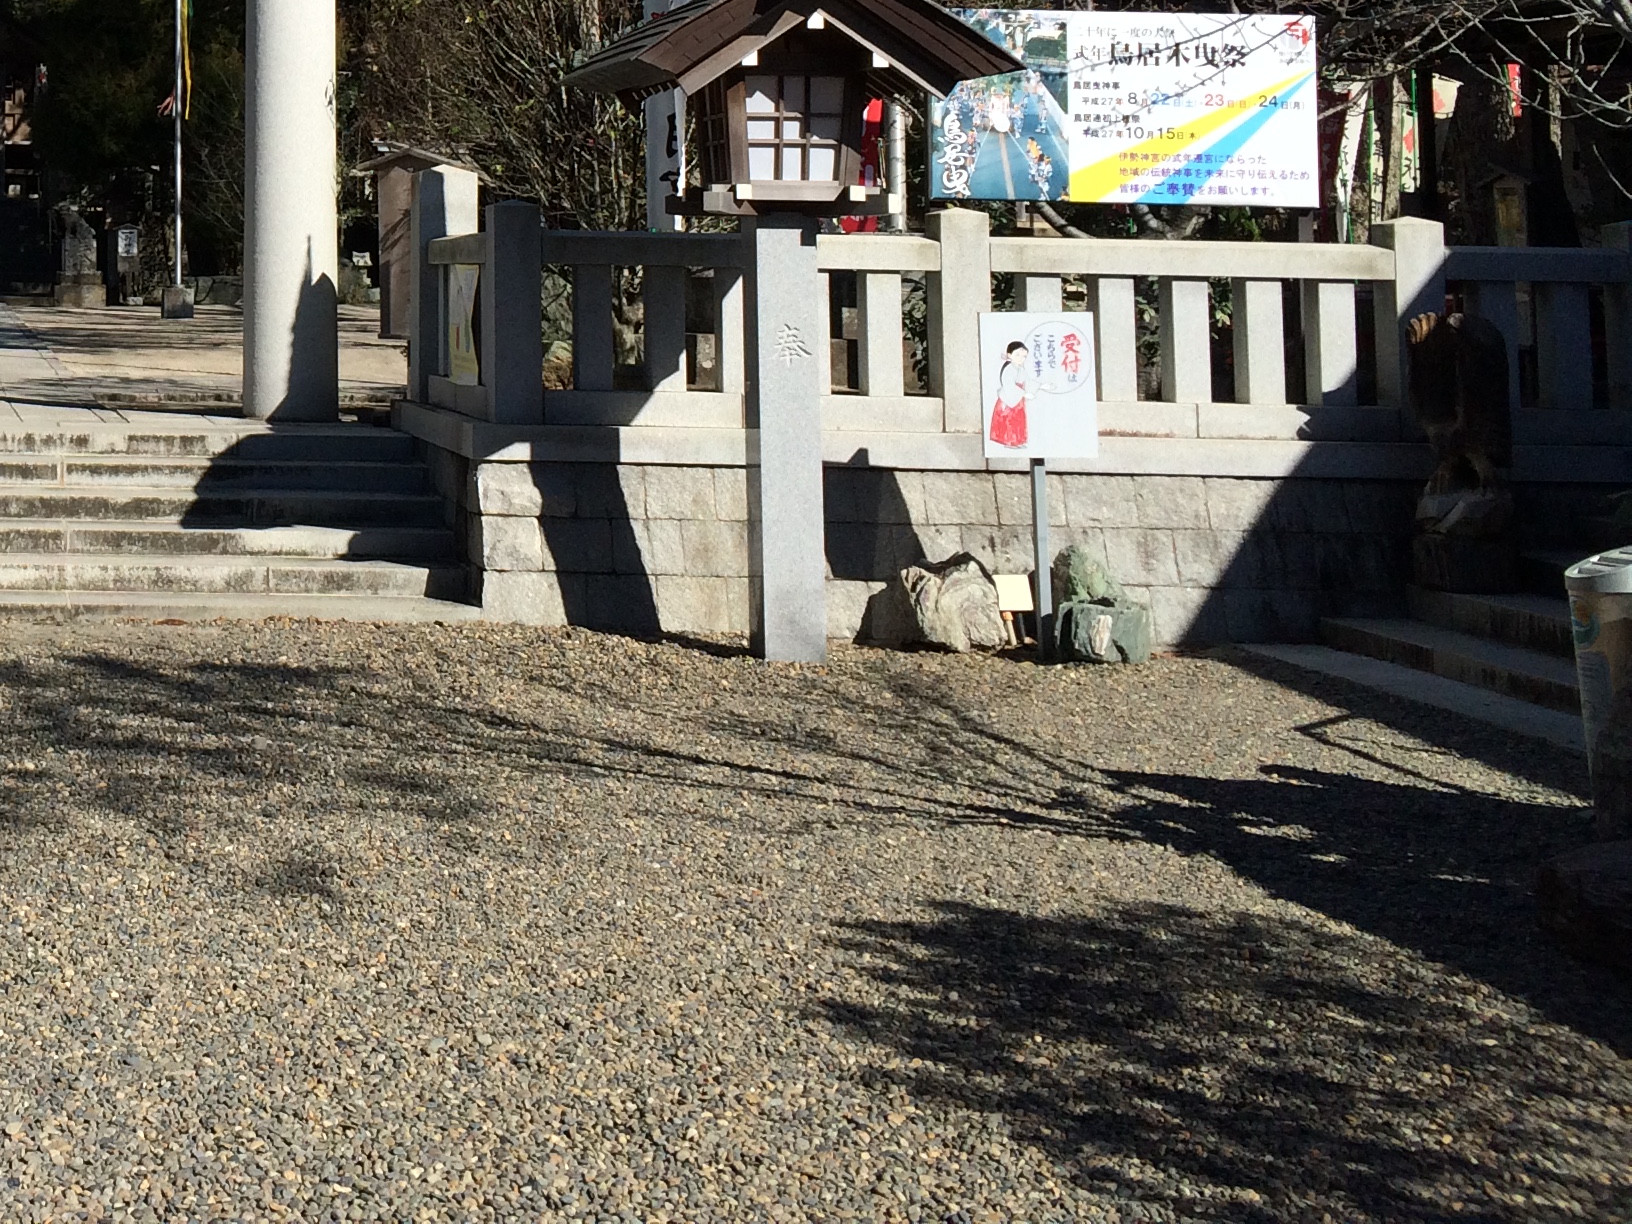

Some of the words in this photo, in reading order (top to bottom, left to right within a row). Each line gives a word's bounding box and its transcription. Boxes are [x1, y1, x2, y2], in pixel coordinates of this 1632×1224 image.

[1119, 152, 1267, 165] 伊勢神宮の式年遷宮にならった
[1119, 167, 1309, 180] 地域の伝統神事を未来に守り伝えるため
[1119, 181, 1274, 197] 皆様のご奉賛をお願いします。
[772, 323, 813, 368] 奉
[1060, 332, 1082, 382] 受付は
